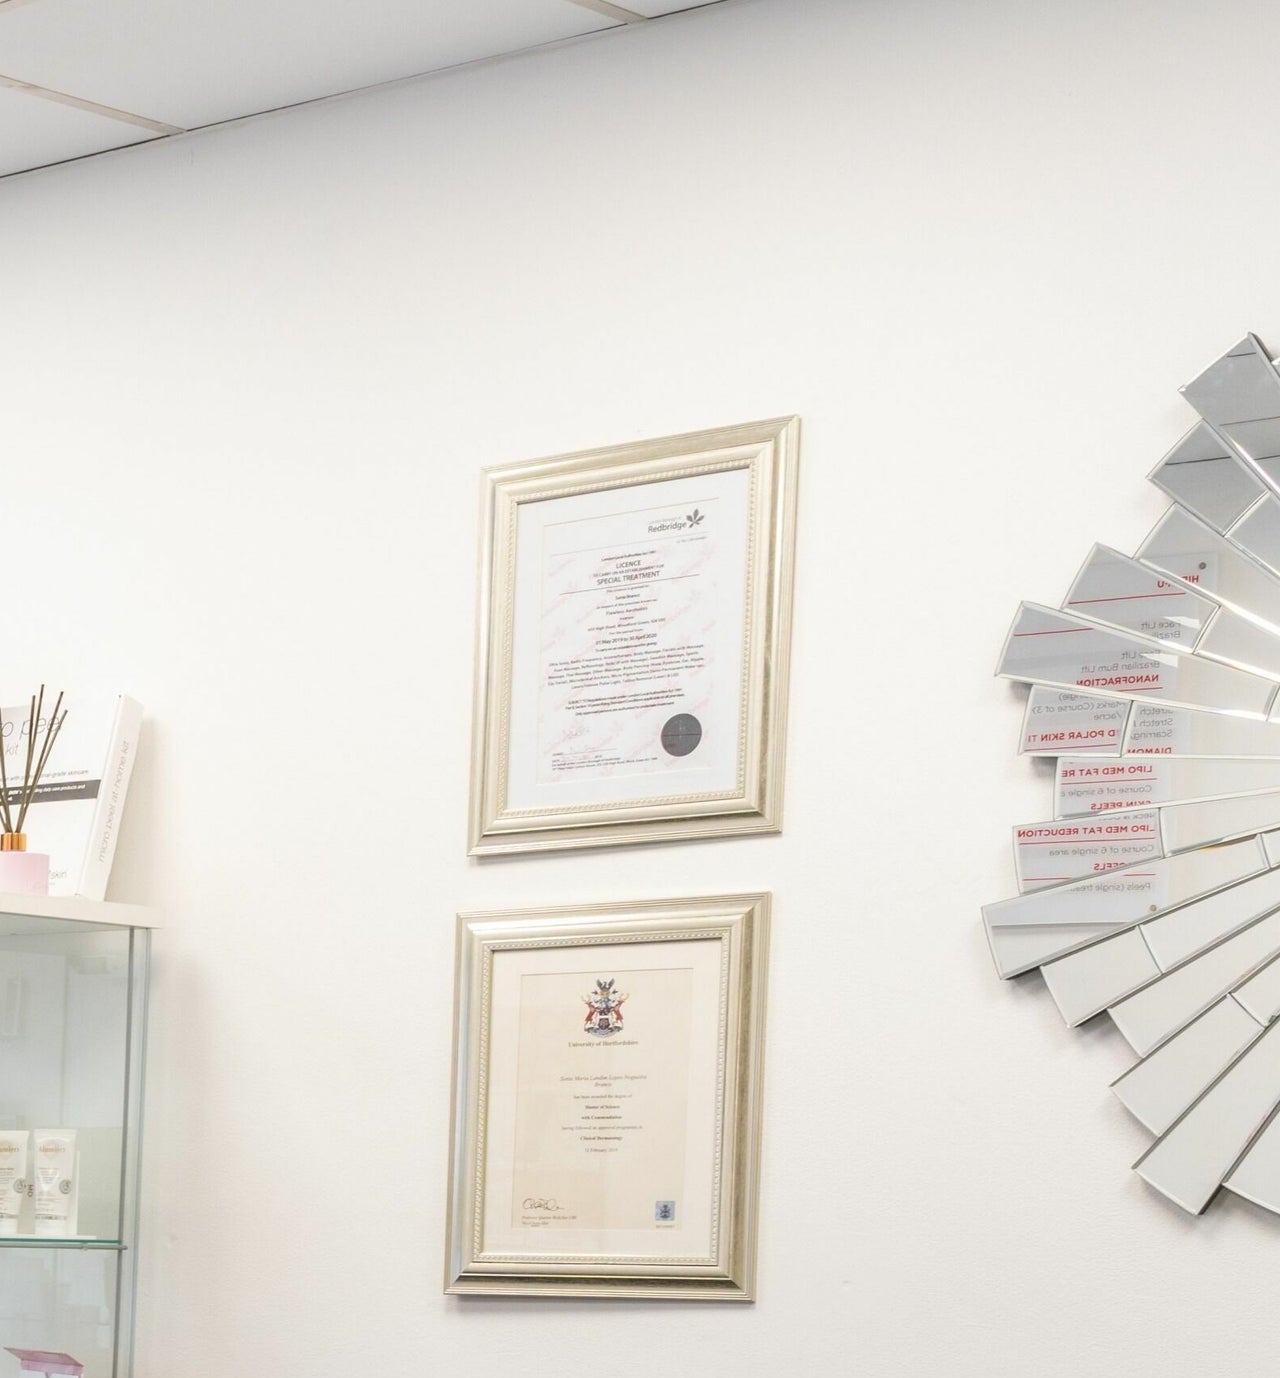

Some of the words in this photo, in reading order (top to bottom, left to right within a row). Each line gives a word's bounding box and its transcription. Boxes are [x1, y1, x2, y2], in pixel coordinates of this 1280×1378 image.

[647, 519, 687, 533] Redbridge
[616, 560, 641, 570] LICENCE
[597, 576, 622, 586] SPECIAL
[623, 571, 661, 582] TREATMENT
[4, 743, 21, 756] kit
